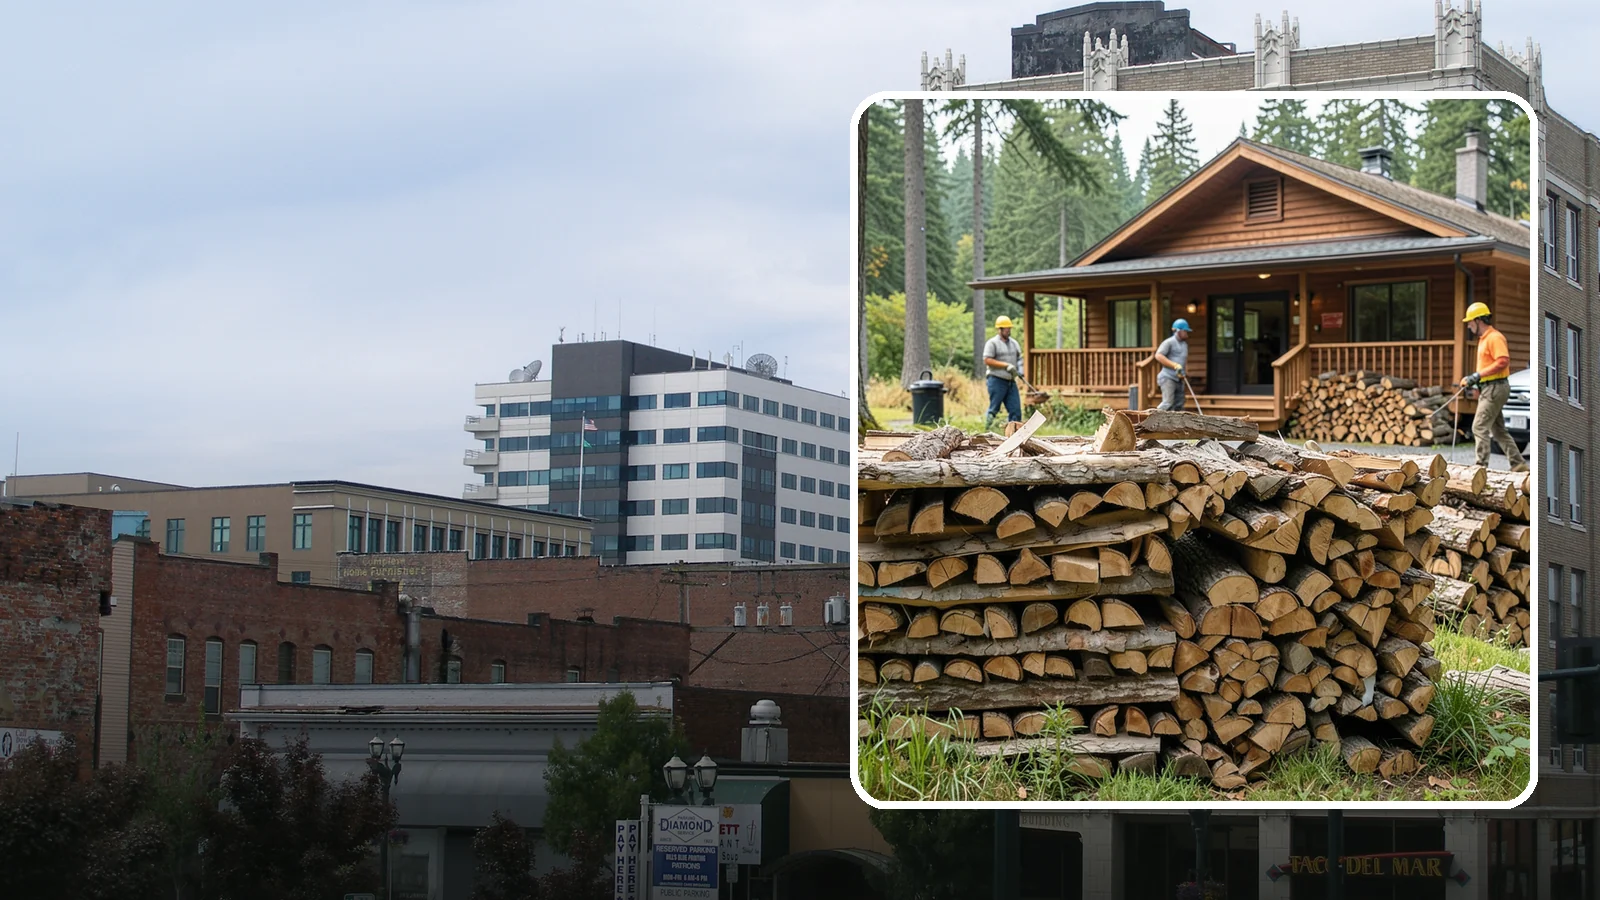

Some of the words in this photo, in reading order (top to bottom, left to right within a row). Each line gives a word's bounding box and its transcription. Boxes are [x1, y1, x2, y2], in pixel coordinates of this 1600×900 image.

[370, 566, 427, 577] Furnishers
[660, 818, 713, 833] DIAMOND
[1022, 815, 1070, 827] BUILDING
[617, 825, 625, 852] PAY
[628, 824, 637, 852] PAY
[655, 845, 688, 853] RESERVED
[689, 846, 716, 854] PARKING
[721, 851, 739, 862] Soup
[671, 862, 701, 870] PATRONS
[1346, 856, 1385, 875] DEL
[1392, 857, 1442, 877] MAR
[616, 856, 625, 894] HERE
[627, 855, 636, 893] HERE
[660, 888, 682, 897] PUBLIC
[683, 889, 710, 898] PARKING
